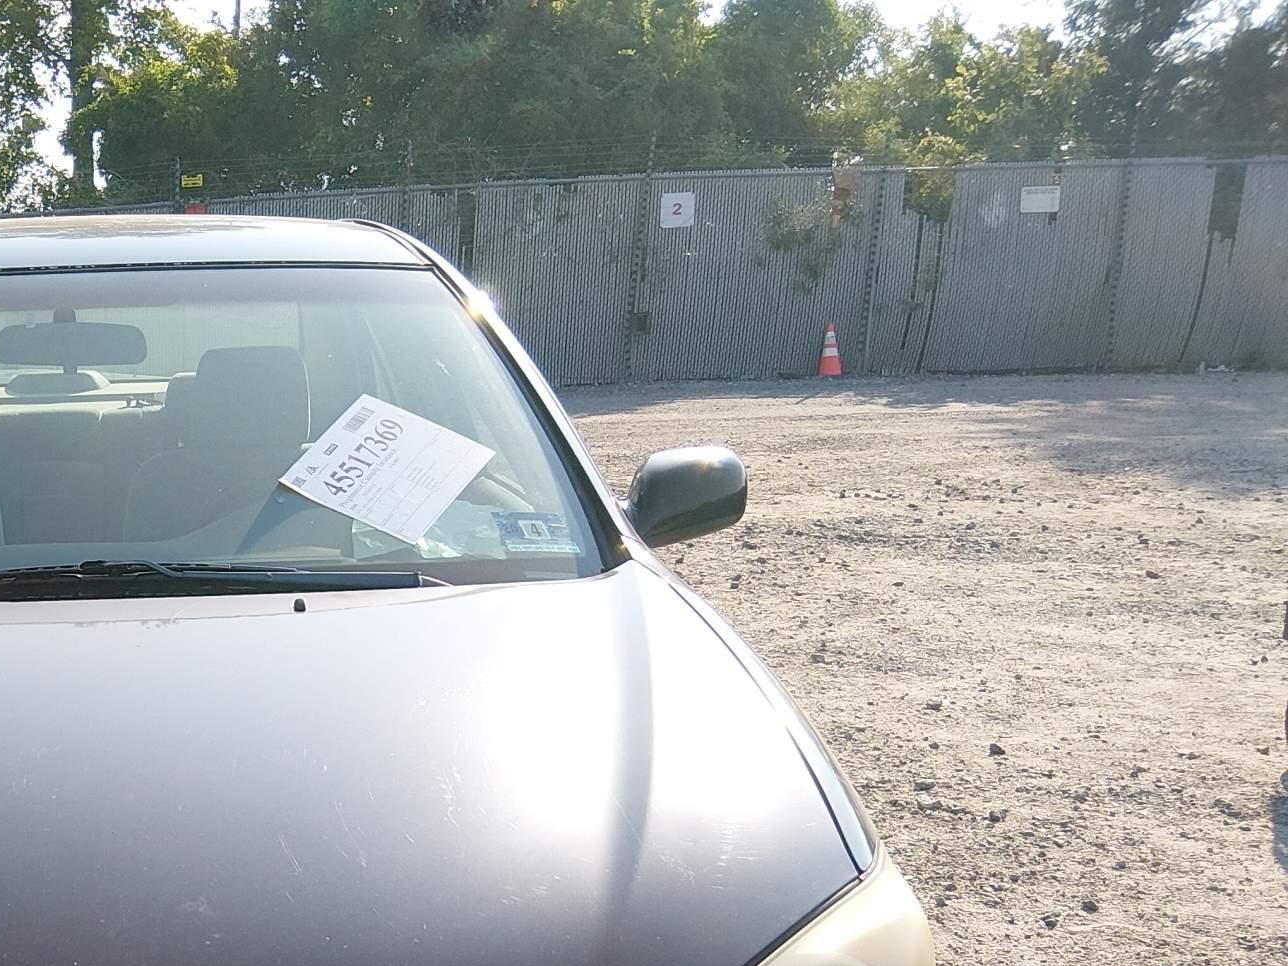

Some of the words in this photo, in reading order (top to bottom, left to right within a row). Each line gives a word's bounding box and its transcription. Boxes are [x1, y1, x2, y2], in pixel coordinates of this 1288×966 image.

[672, 202, 682, 216] 2
[323, 419, 403, 496] 45517369
[531, 523, 542, 537] 4
